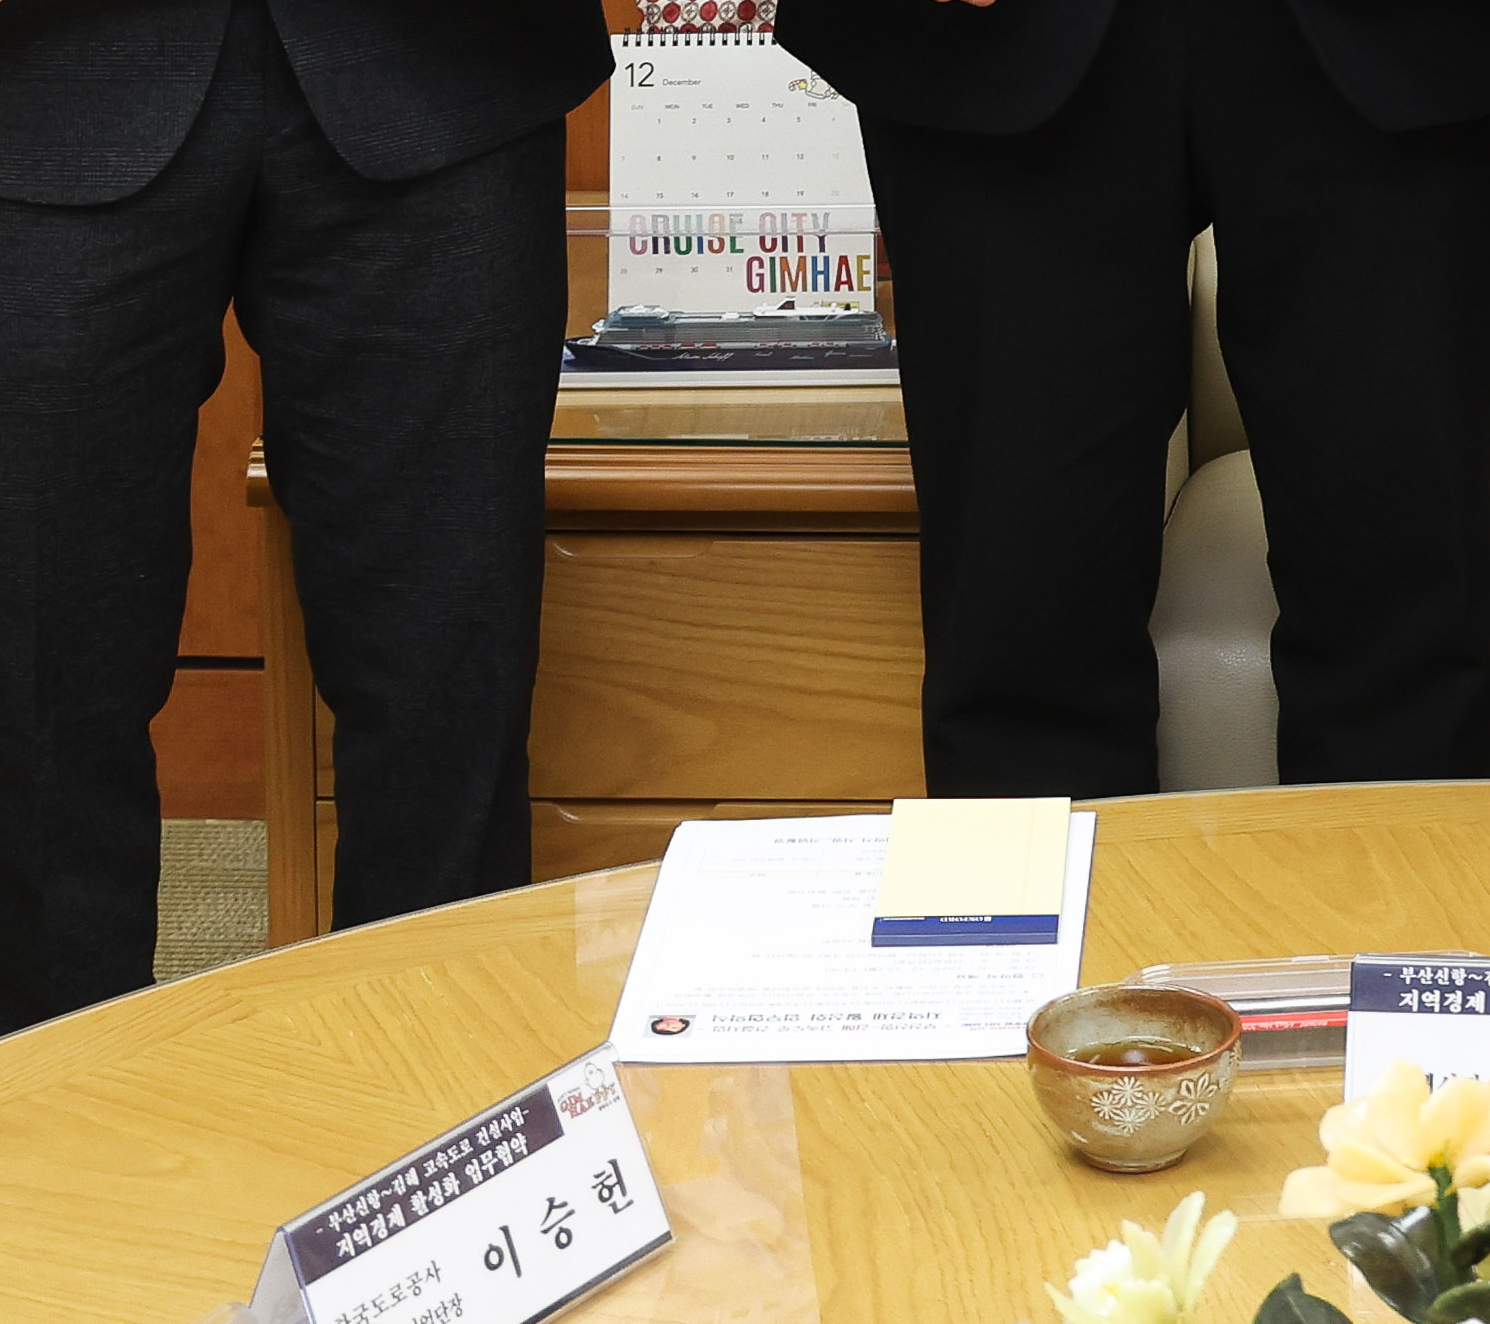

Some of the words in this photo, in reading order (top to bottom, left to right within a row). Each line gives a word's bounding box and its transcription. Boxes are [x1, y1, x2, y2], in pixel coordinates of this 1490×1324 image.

[625, 62, 654, 88] 12
[662, 78, 701, 87] December
[629, 212, 745, 256] CRUISE
[758, 211, 831, 254] CITY
[746, 255, 872, 294] GIMHAE
[1398, 991, 1486, 1015] 지역경제
[423, 1134, 475, 1180] 고속도로
[335, 1205, 407, 1260] 지역경제
[409, 1169, 462, 1218] 활성화
[463, 1132, 531, 1189] 업무협약
